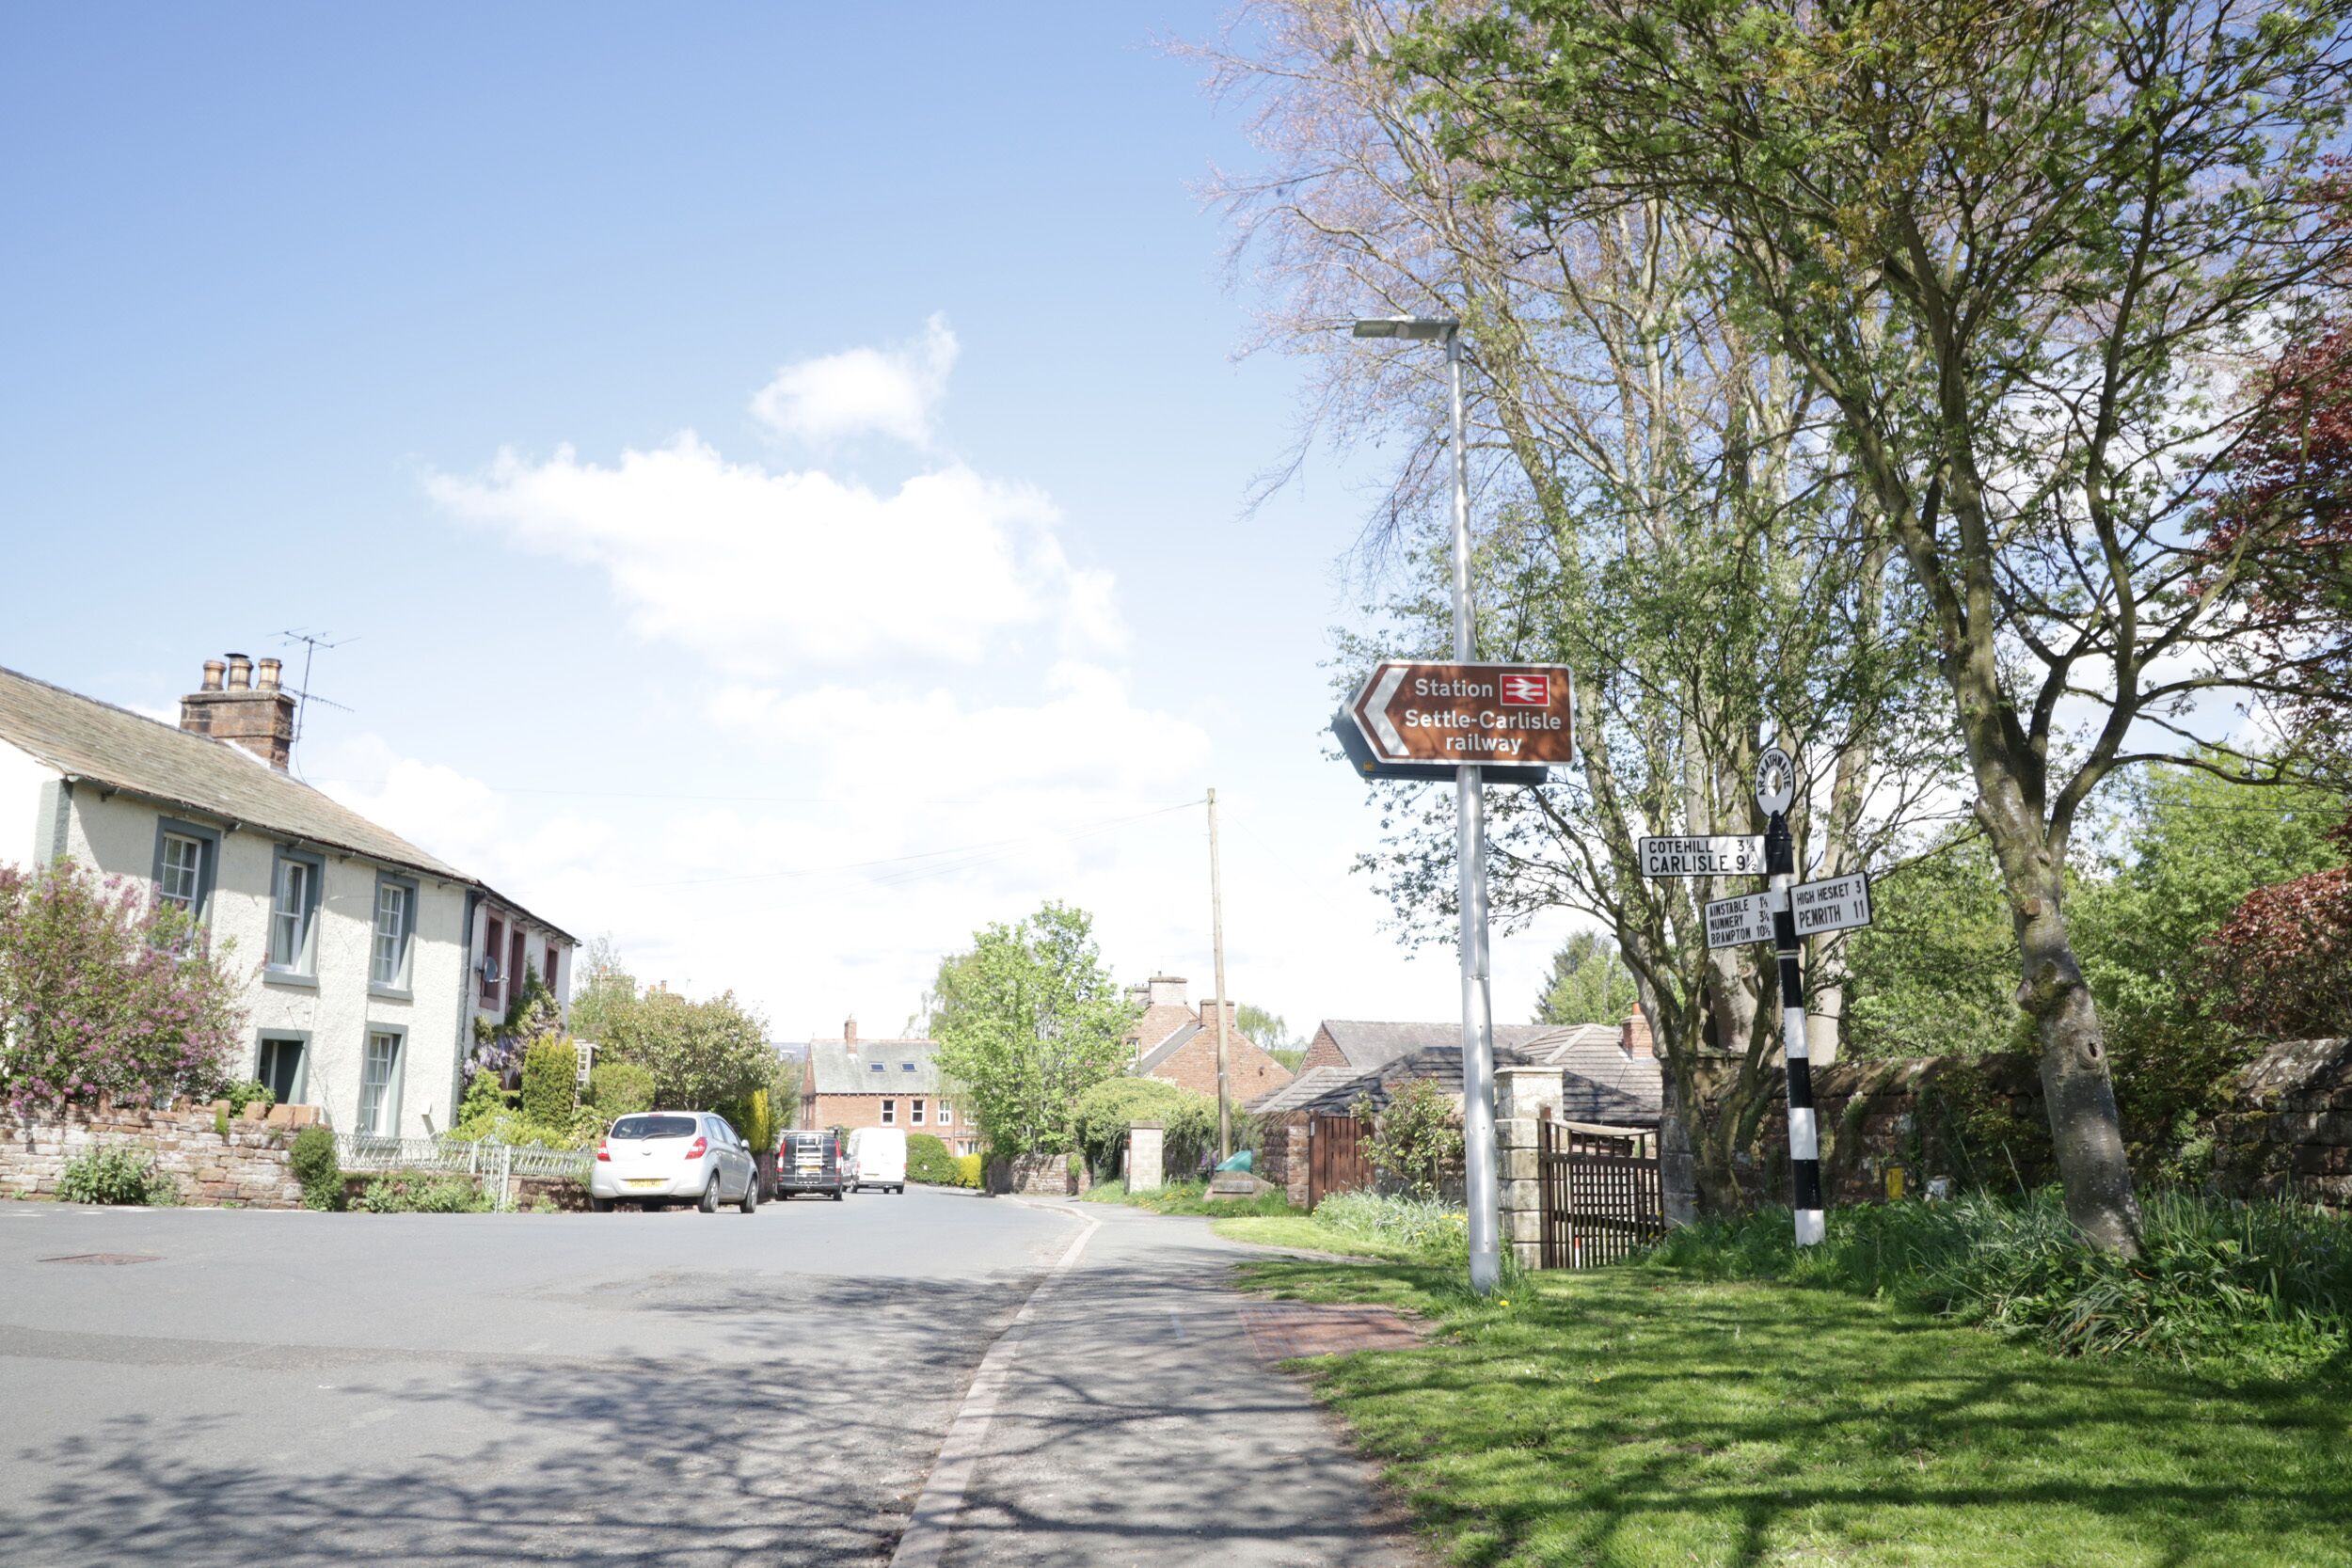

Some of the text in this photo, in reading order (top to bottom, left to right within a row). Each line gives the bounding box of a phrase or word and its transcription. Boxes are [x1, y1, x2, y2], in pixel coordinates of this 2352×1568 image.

[1415, 678, 1493, 698] Station
[1405, 709, 1562, 730] Settle-Carlisle
[1445, 734, 1522, 755] railway
[1757, 753, 1792, 796] ARMATHWAITE
[1648, 841, 1714, 854] COTEHILL
[1649, 855, 1729, 873] CARLISLE
[1796, 880, 1862, 907] HIGH HESKET 3
[1709, 898, 1750, 918] AINSTABLE
[1799, 899, 1865, 929] PENRITH 11
[1709, 913, 1744, 932] NUNNERY
[1710, 927, 1752, 945] BRAMPTON
